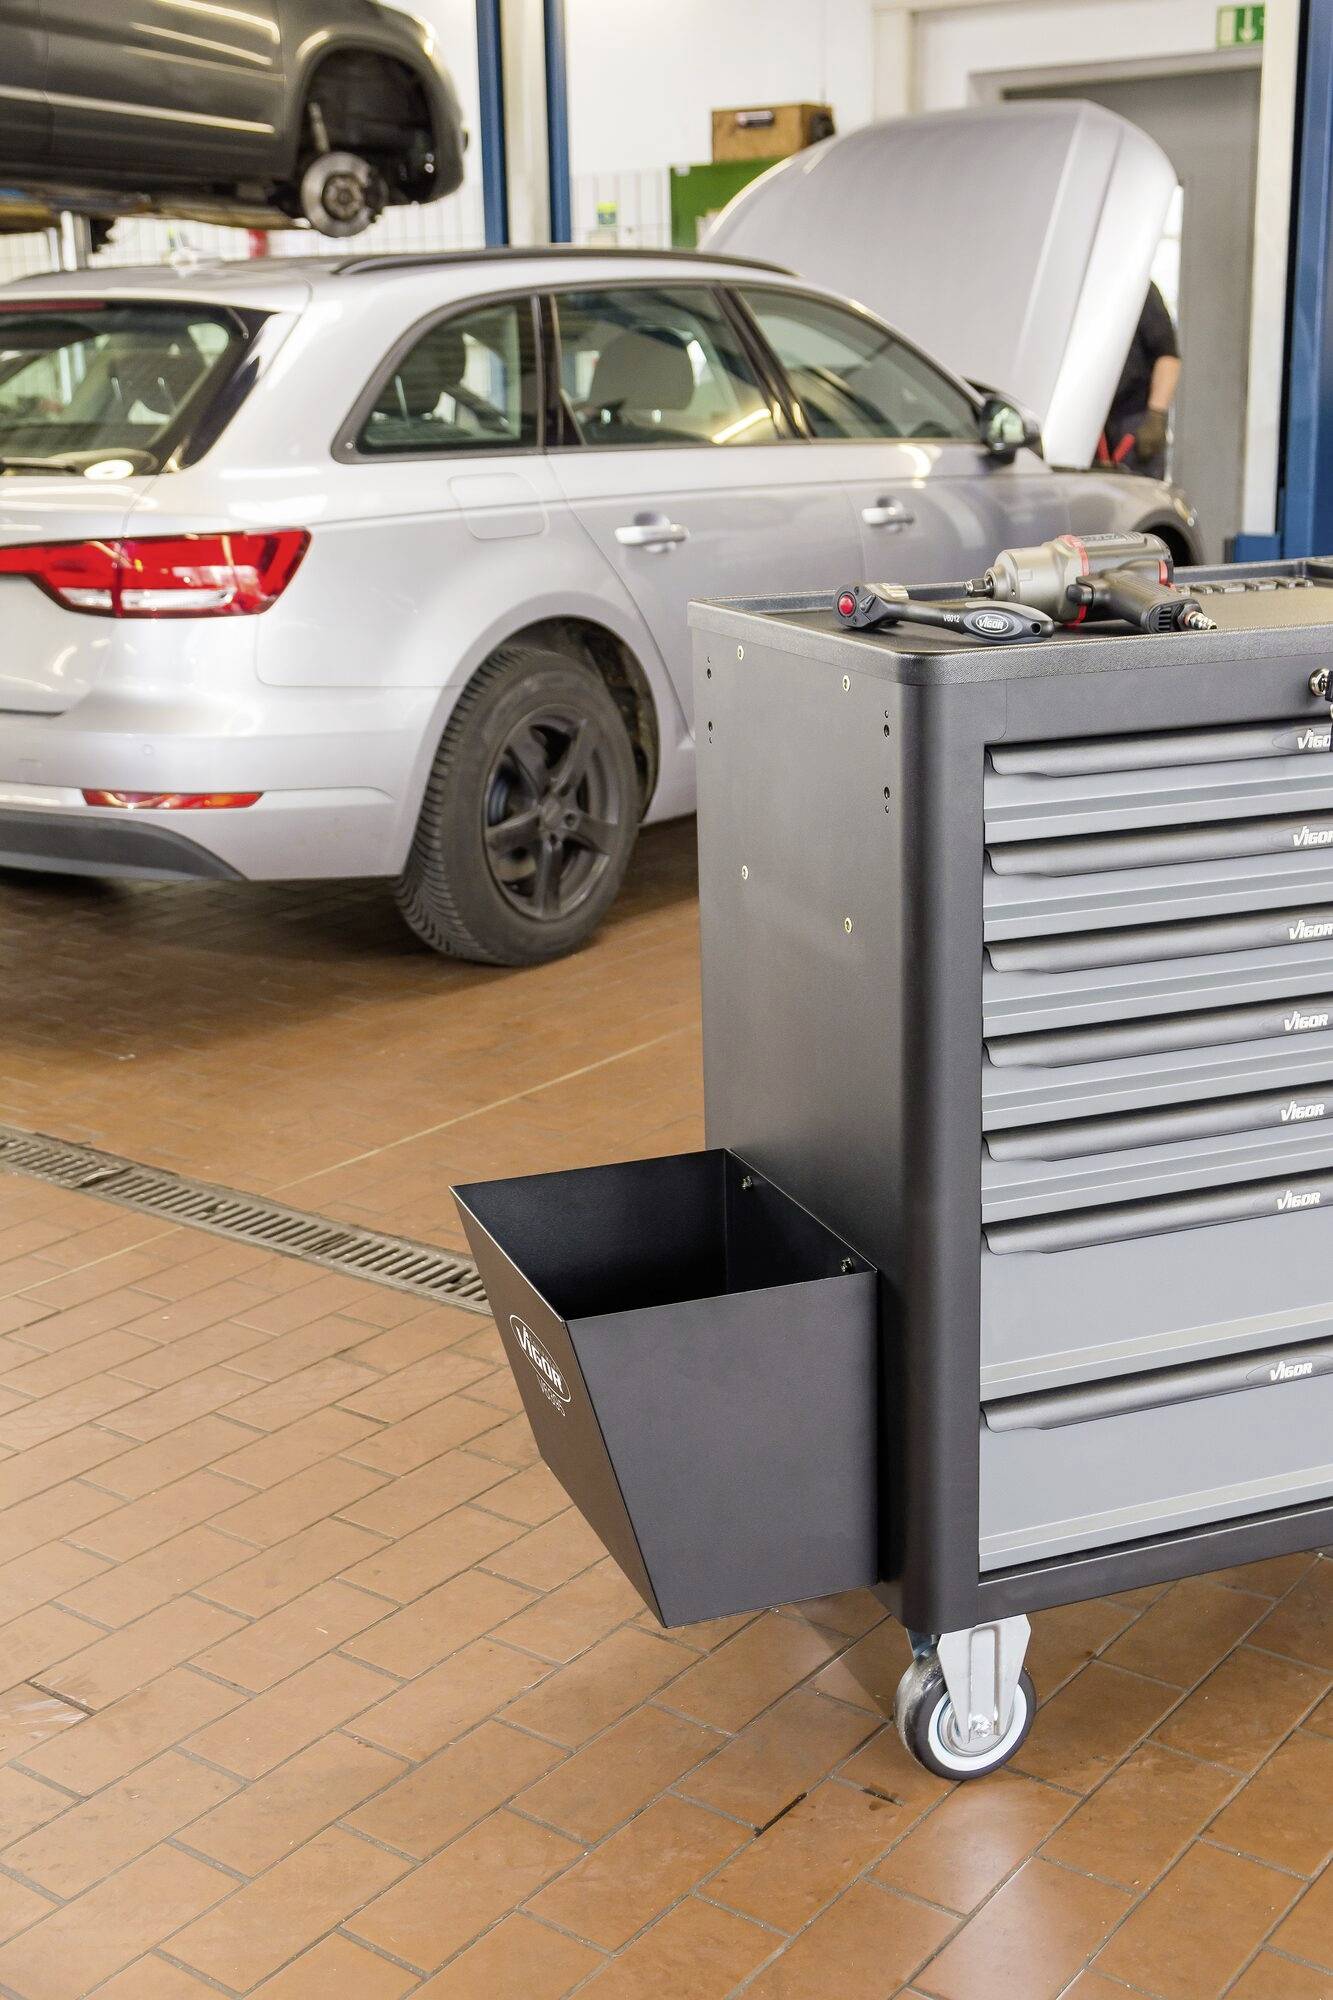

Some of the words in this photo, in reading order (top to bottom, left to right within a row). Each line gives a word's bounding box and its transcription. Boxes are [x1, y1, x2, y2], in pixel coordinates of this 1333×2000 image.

[979, 616, 1004, 630] VIGOR
[1288, 919, 1333, 940] VIGOR
[1284, 1010, 1329, 1031] VIGOR
[1280, 1100, 1325, 1121] VIGOR
[1276, 1189, 1321, 1210] VIGOR
[515, 1325, 565, 1394] VIGOR
[1270, 1360, 1312, 1381] VIGOR
